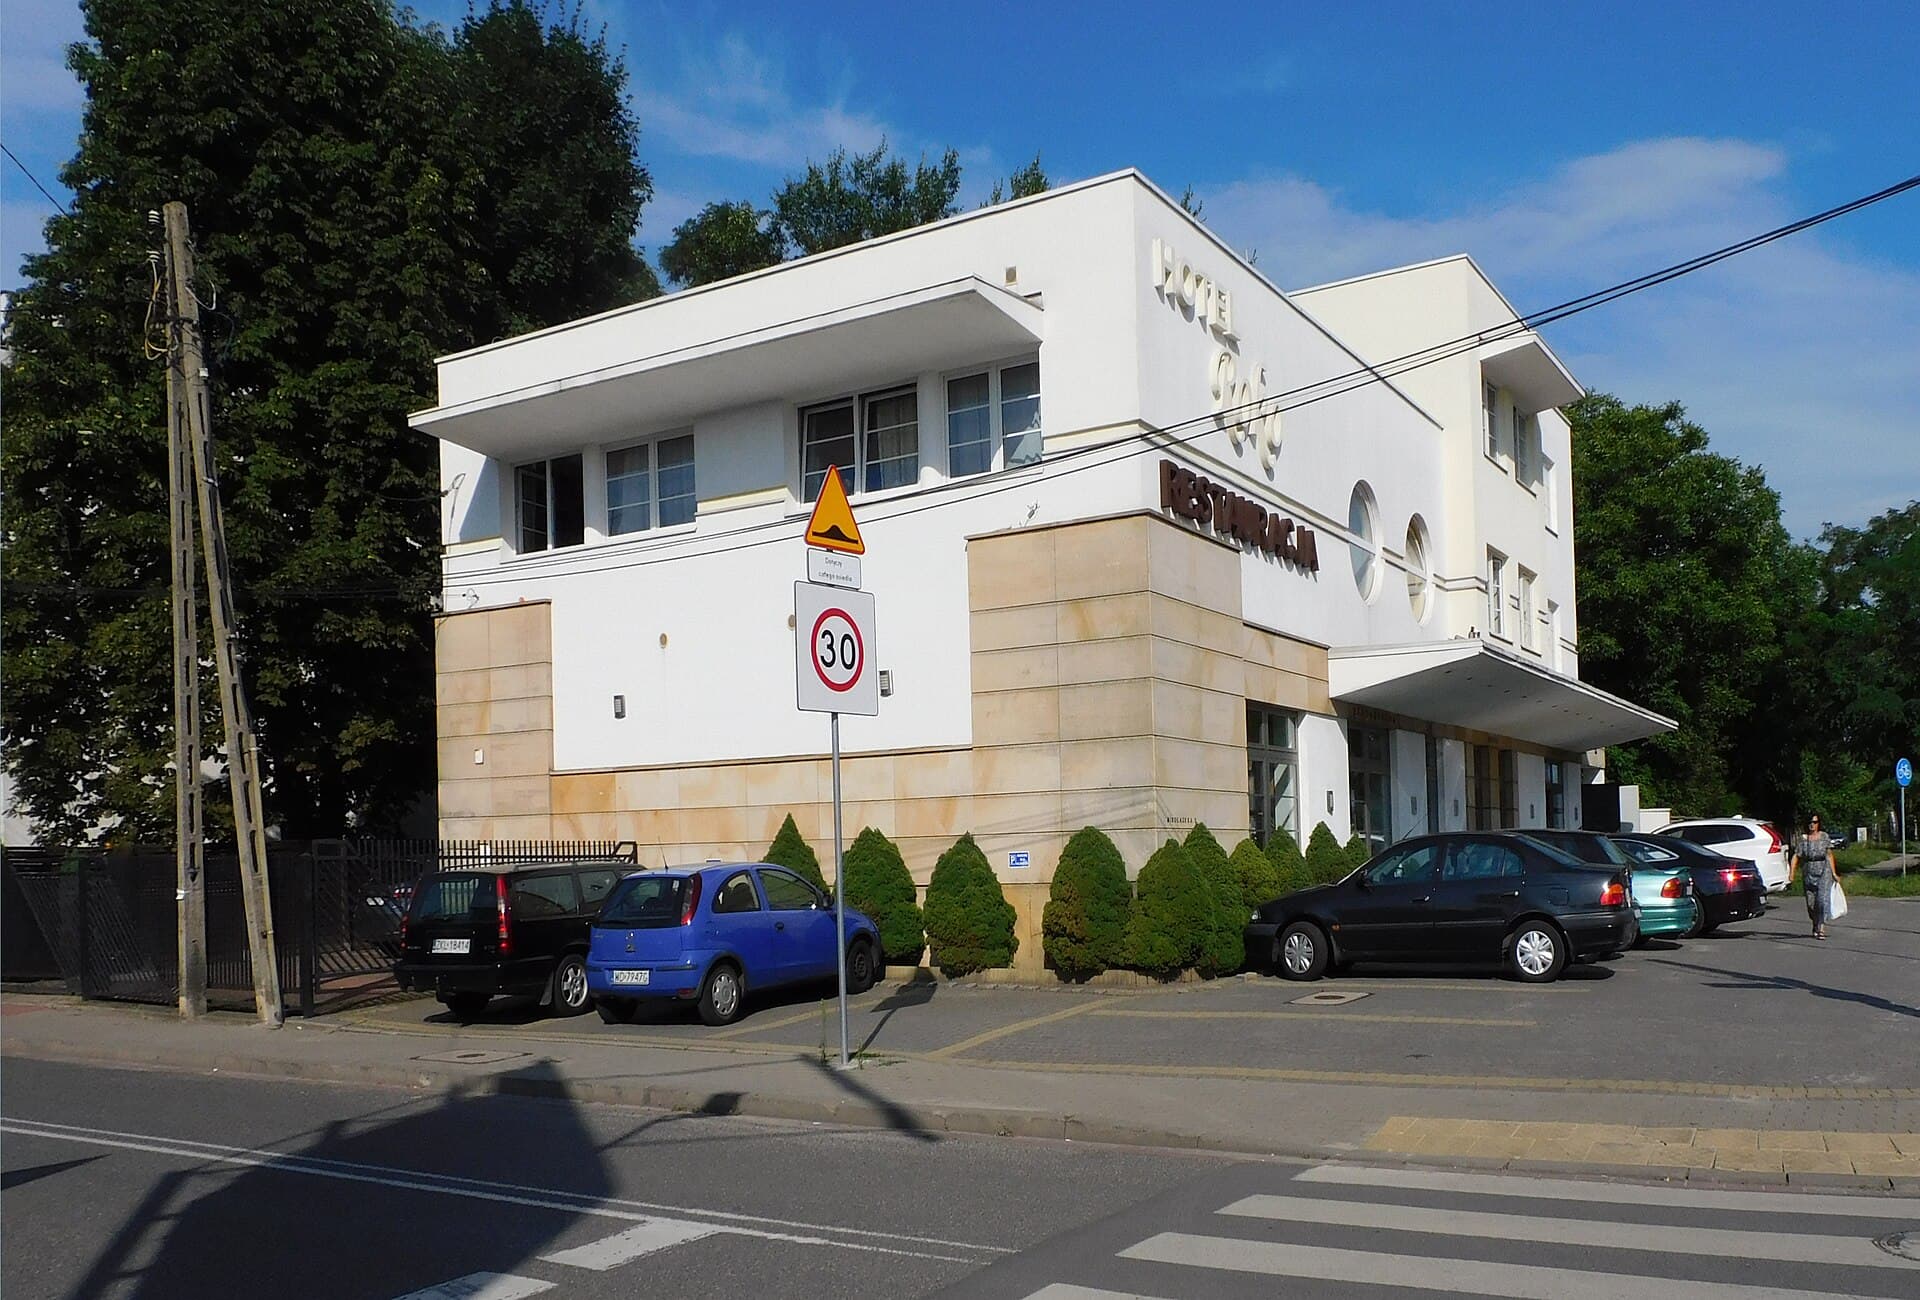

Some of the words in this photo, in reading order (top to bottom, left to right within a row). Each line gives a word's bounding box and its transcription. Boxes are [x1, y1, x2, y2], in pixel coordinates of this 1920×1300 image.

[1151, 237, 1240, 342] HOTEL
[1159, 459, 1319, 571] RESTAURACJA
[820, 629, 856, 670] 30
